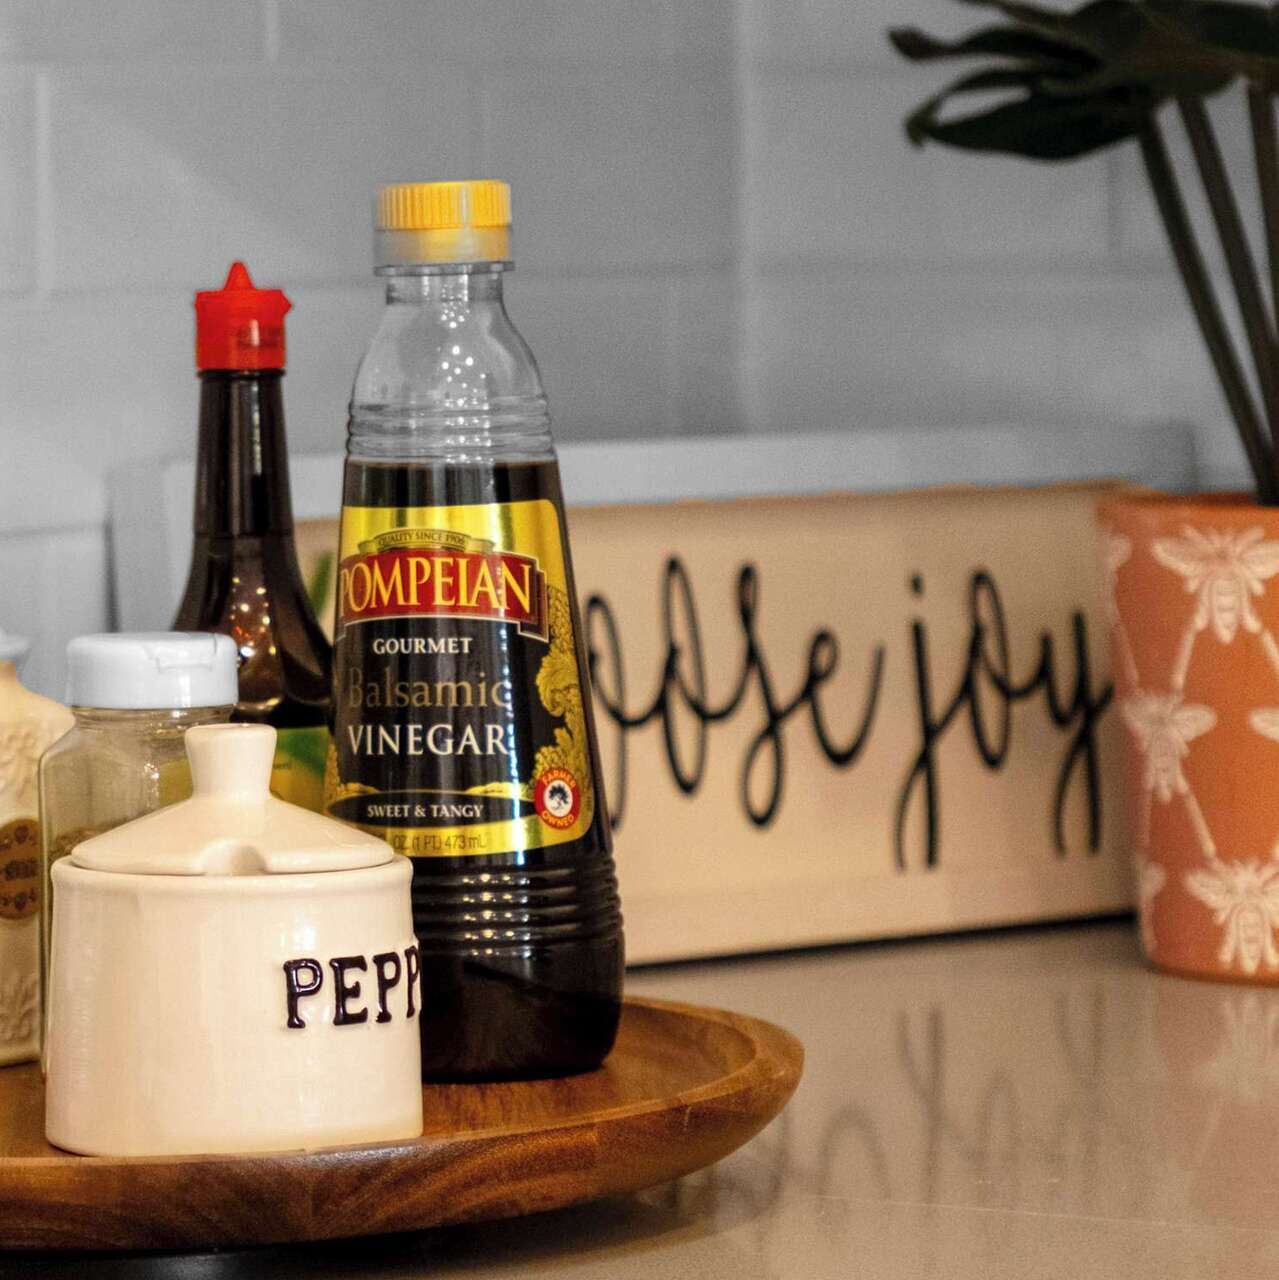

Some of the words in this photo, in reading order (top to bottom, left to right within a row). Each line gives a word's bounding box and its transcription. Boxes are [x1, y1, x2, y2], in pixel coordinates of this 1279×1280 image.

[377, 531, 413, 546] QUALITY
[415, 530, 442, 541] SINCE
[341, 556, 532, 616] POMPEIAN
[372, 637, 473, 655] GOURMET
[347, 666, 510, 708] Balsamic
[894, 568, 1116, 870] joy
[347, 723, 510, 756] VINEGAR
[367, 804, 411, 818] SWEET
[414, 804, 427, 818] &
[430, 804, 484, 818] TANGY
[444, 833, 467, 850] 473
[282, 945, 421, 1029] PEPP
